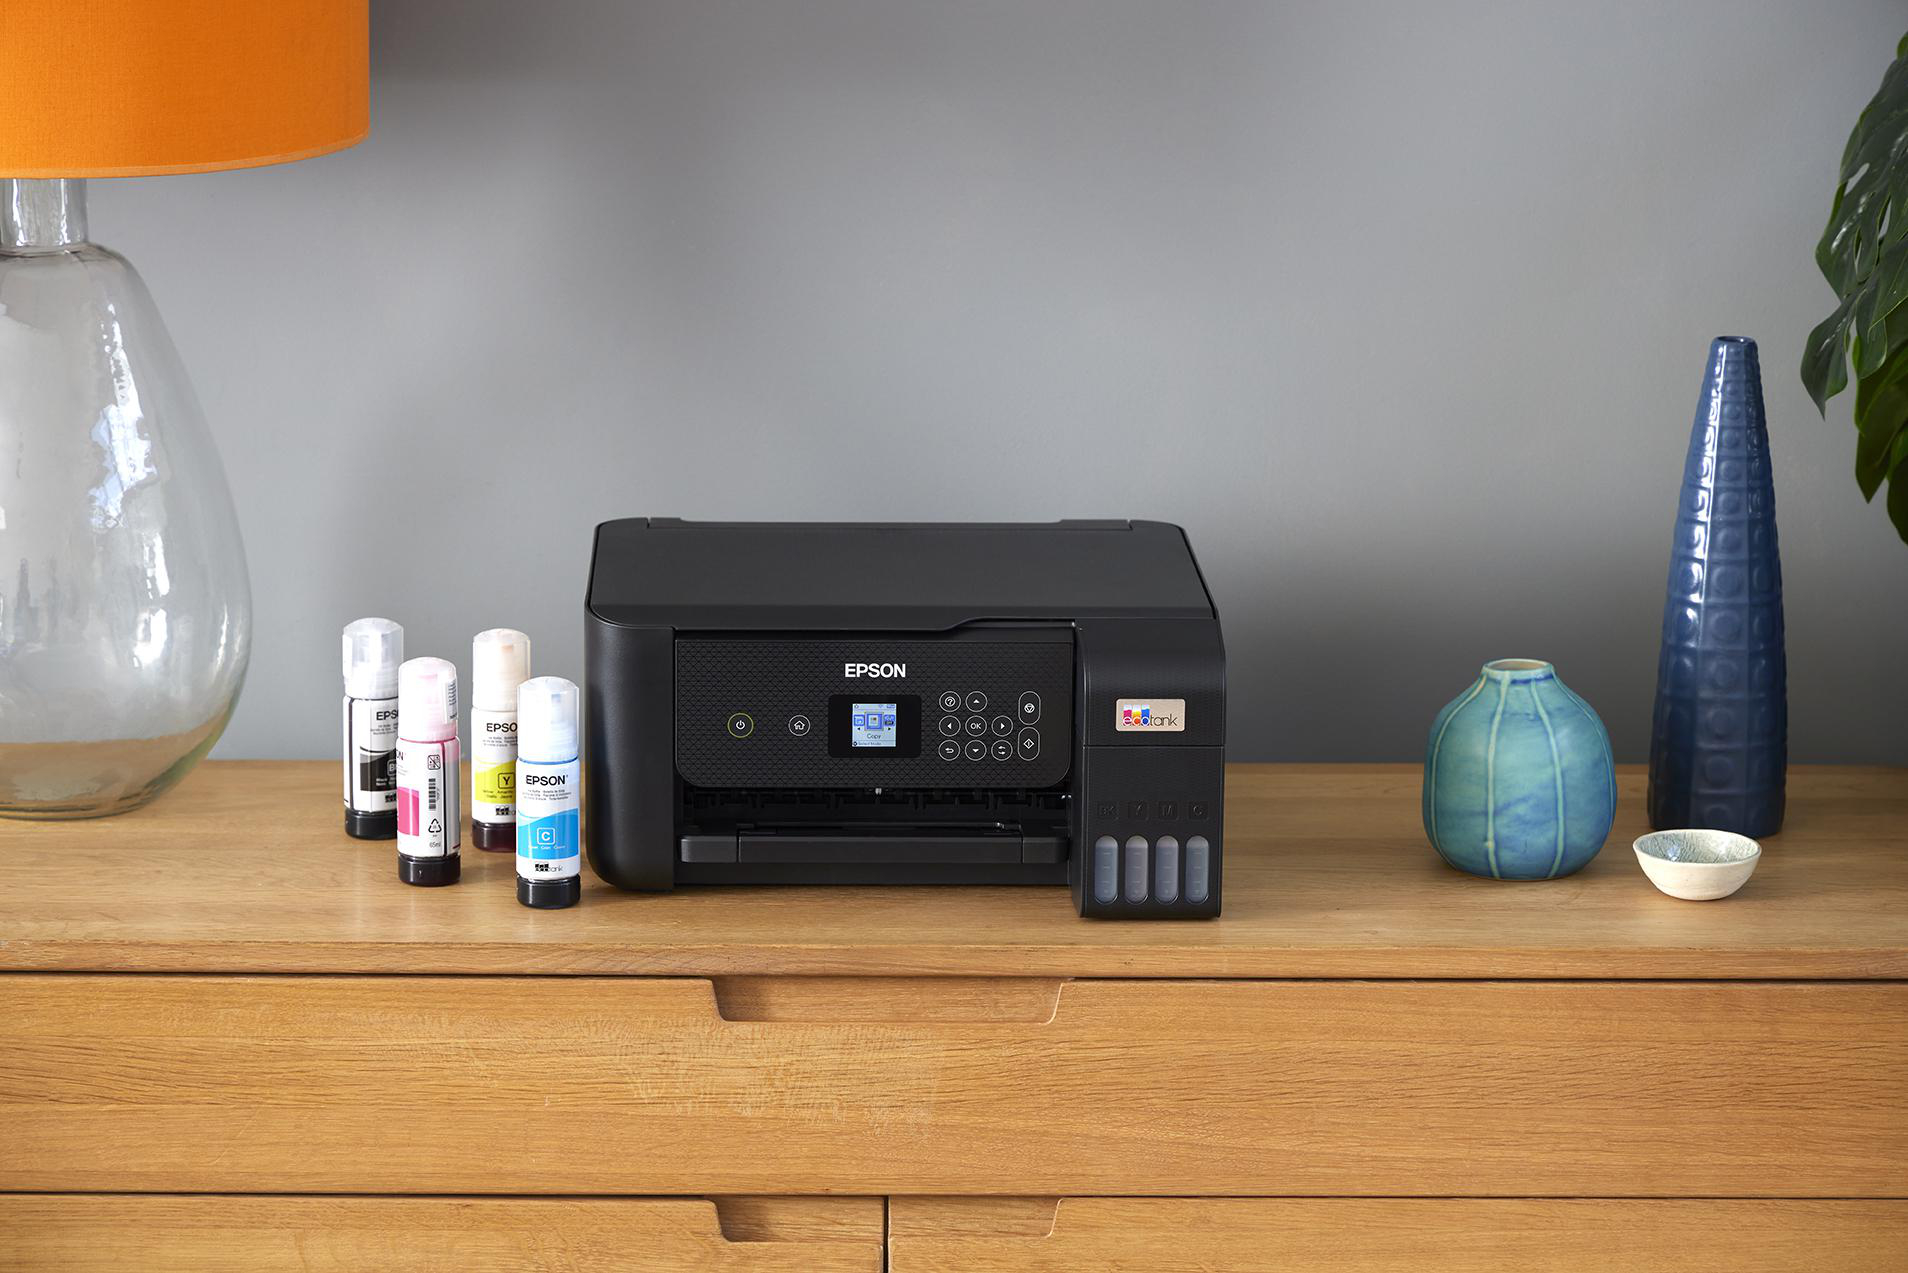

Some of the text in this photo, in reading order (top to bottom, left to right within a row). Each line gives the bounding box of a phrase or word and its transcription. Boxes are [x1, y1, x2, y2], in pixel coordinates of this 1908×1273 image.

[844, 662, 906, 678] EPSON
[376, 709, 398, 721] EPS
[1122, 713, 1178, 727] ecotank
[486, 722, 518, 733] EPSO
[970, 722, 982, 730] OK
[502, 776, 511, 786] Y
[525, 774, 566, 786] EPSON
[541, 831, 551, 842] C
